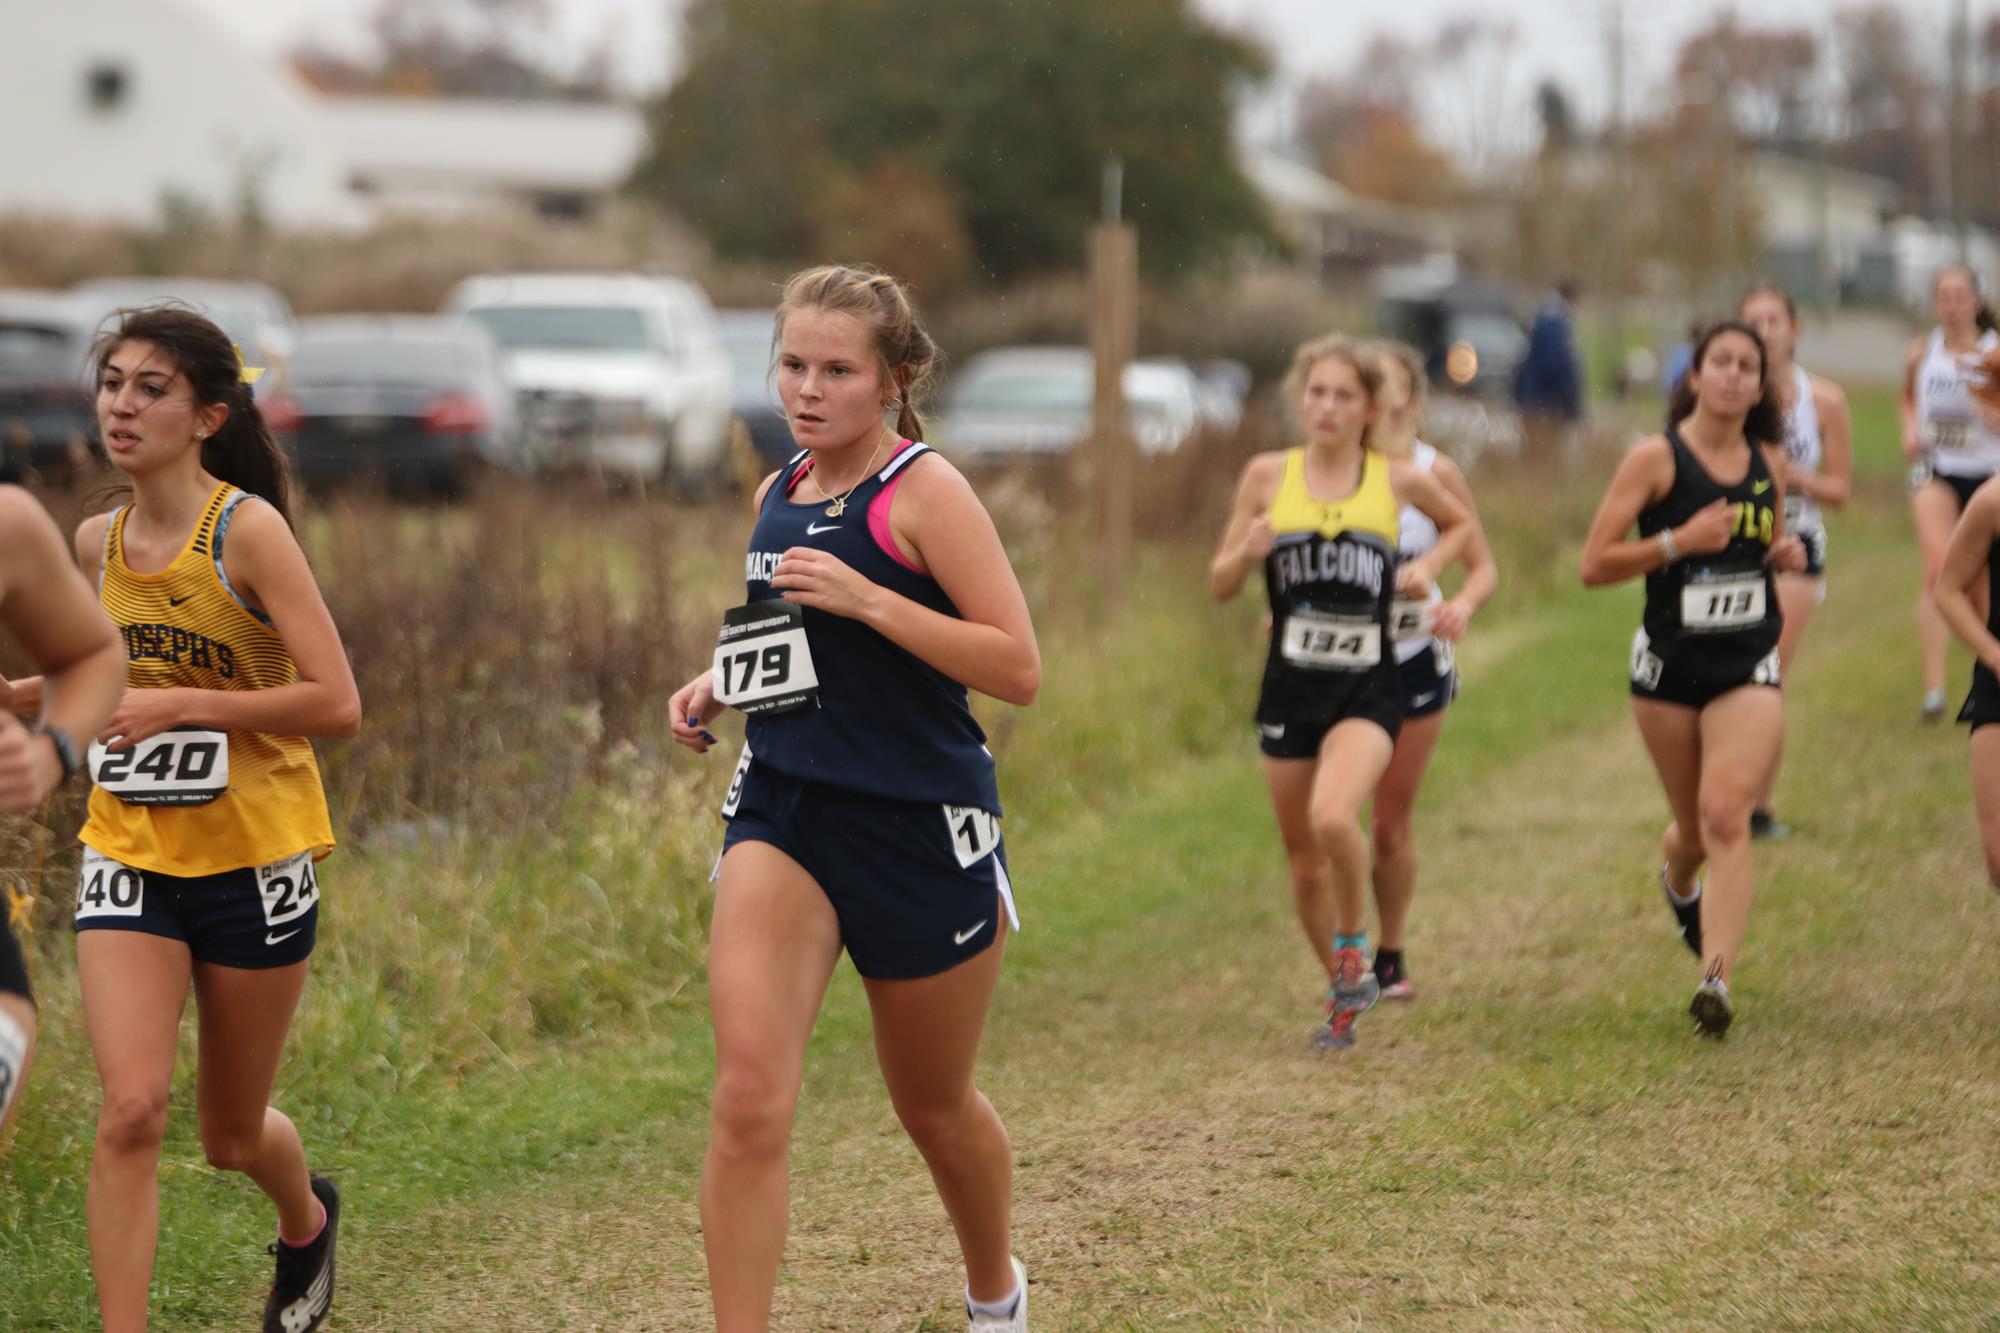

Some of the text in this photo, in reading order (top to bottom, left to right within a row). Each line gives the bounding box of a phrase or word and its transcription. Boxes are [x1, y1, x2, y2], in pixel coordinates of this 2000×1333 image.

[1277, 541, 1384, 599] FALCONS
[747, 614, 791, 631] CHAMPIONSHIPS
[1708, 590, 1754, 616] 113
[1302, 630, 1364, 656] 134
[722, 643, 792, 697] 179
[98, 742, 220, 782] 240
[77, 868, 140, 911] 40
[266, 862, 319, 918] 24
